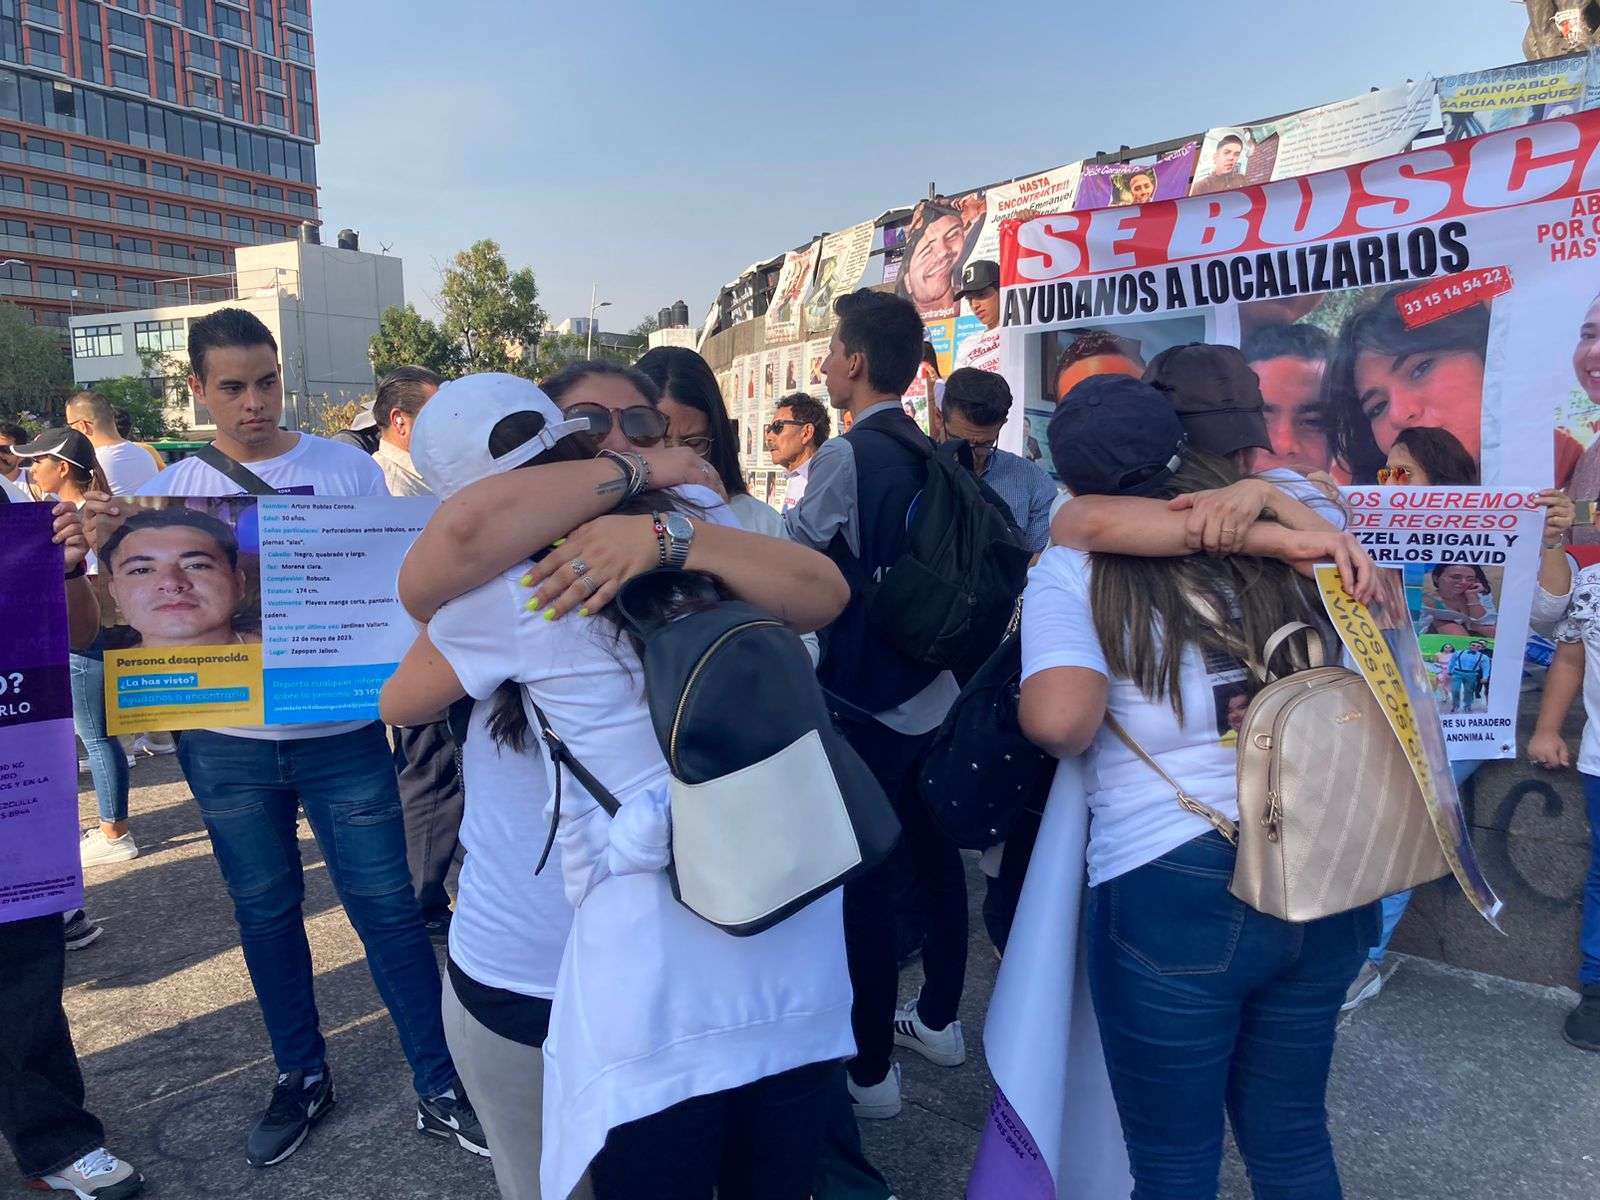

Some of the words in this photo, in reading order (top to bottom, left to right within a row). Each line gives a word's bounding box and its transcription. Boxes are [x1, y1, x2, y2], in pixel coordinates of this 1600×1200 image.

[1460, 85, 1503, 97] JUAN
[1505, 77, 1560, 92] PABLO
[1019, 177, 1050, 194] HASTA
[1016, 210, 1140, 281] SE
[1166, 121, 1600, 262] BUSC
[1537, 219, 1584, 243] POR
[1551, 237, 1600, 262] HAS
[1002, 269, 1158, 327] AYUDANOS
[1167, 266, 1189, 310] A
[1200, 221, 1469, 305] LOCALIZARLOS
[1404, 300, 1422, 315] 33
[1424, 293, 1441, 307] 15
[1443, 285, 1461, 299] 14
[1463, 278, 1482, 292] 54
[1483, 269, 1502, 285] 22
[1389, 491, 1540, 511] QUEREMOS
[1350, 513, 1382, 528] DE
[1387, 513, 1519, 529] REGRESO
[1406, 533, 1496, 547] ABIGAIL
[1503, 534, 1520, 547] Y
[1440, 549, 1506, 564] DAVID
[116, 657, 165, 667] Persona
[168, 653, 249, 666] desaparecida
[120, 679, 139, 689] ¿La
[141, 678, 160, 686] has
[163, 676, 194, 685] visto?
[1455, 719, 1467, 728] SU
[1468, 718, 1511, 727] PARADERO
[1484, 732, 1495, 741] AL
